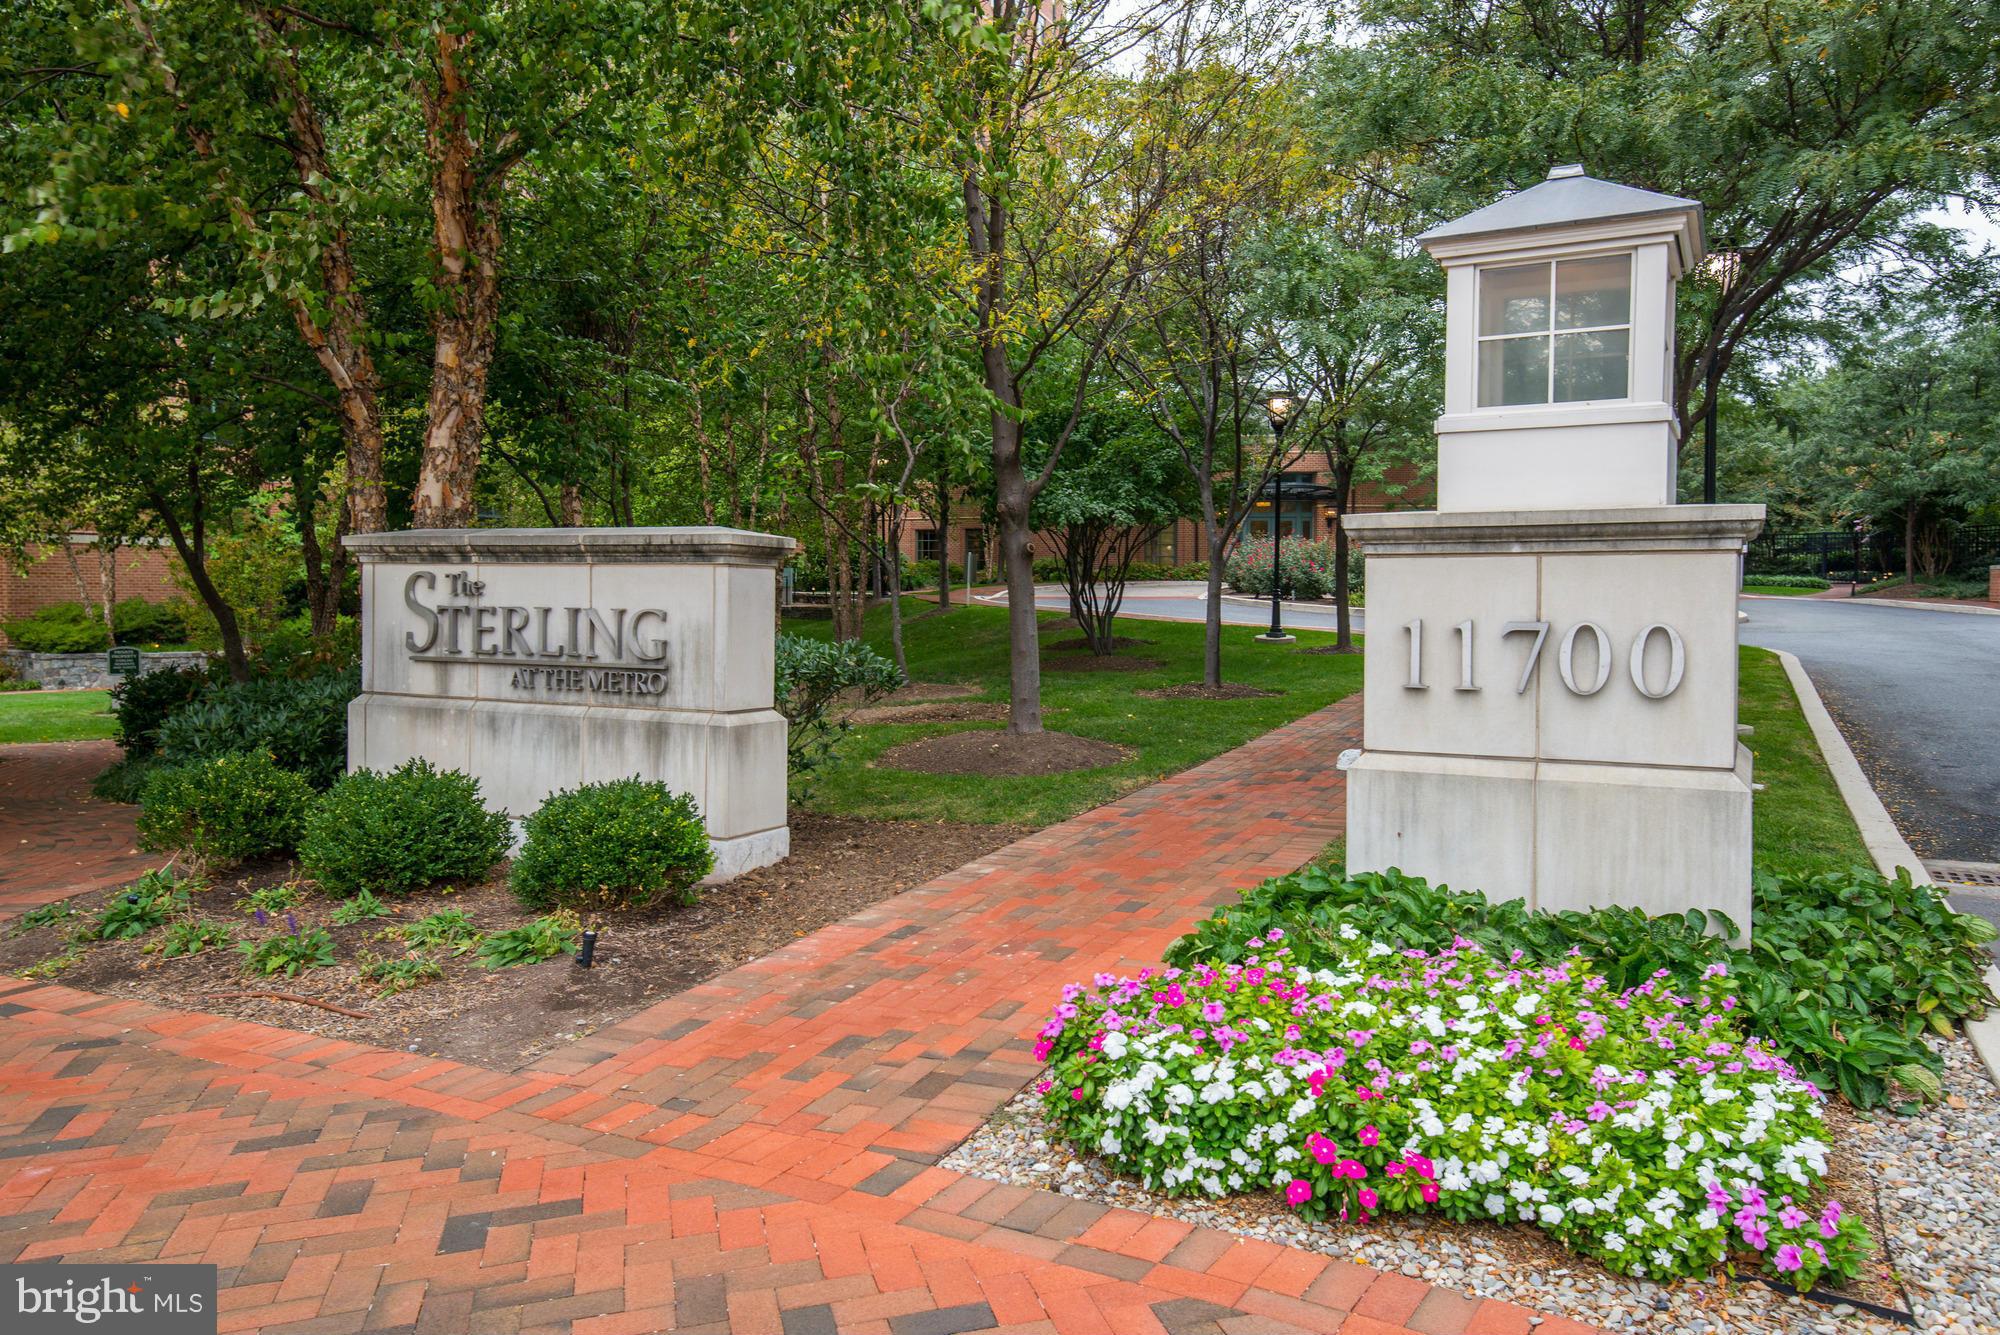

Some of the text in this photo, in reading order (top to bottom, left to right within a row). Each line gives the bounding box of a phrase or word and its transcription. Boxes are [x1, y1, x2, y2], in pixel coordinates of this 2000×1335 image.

[444, 570, 486, 597] The
[404, 570, 668, 662] STERLING
[510, 667, 669, 696] AT THE METRO
[1400, 618, 1687, 699] 11700
